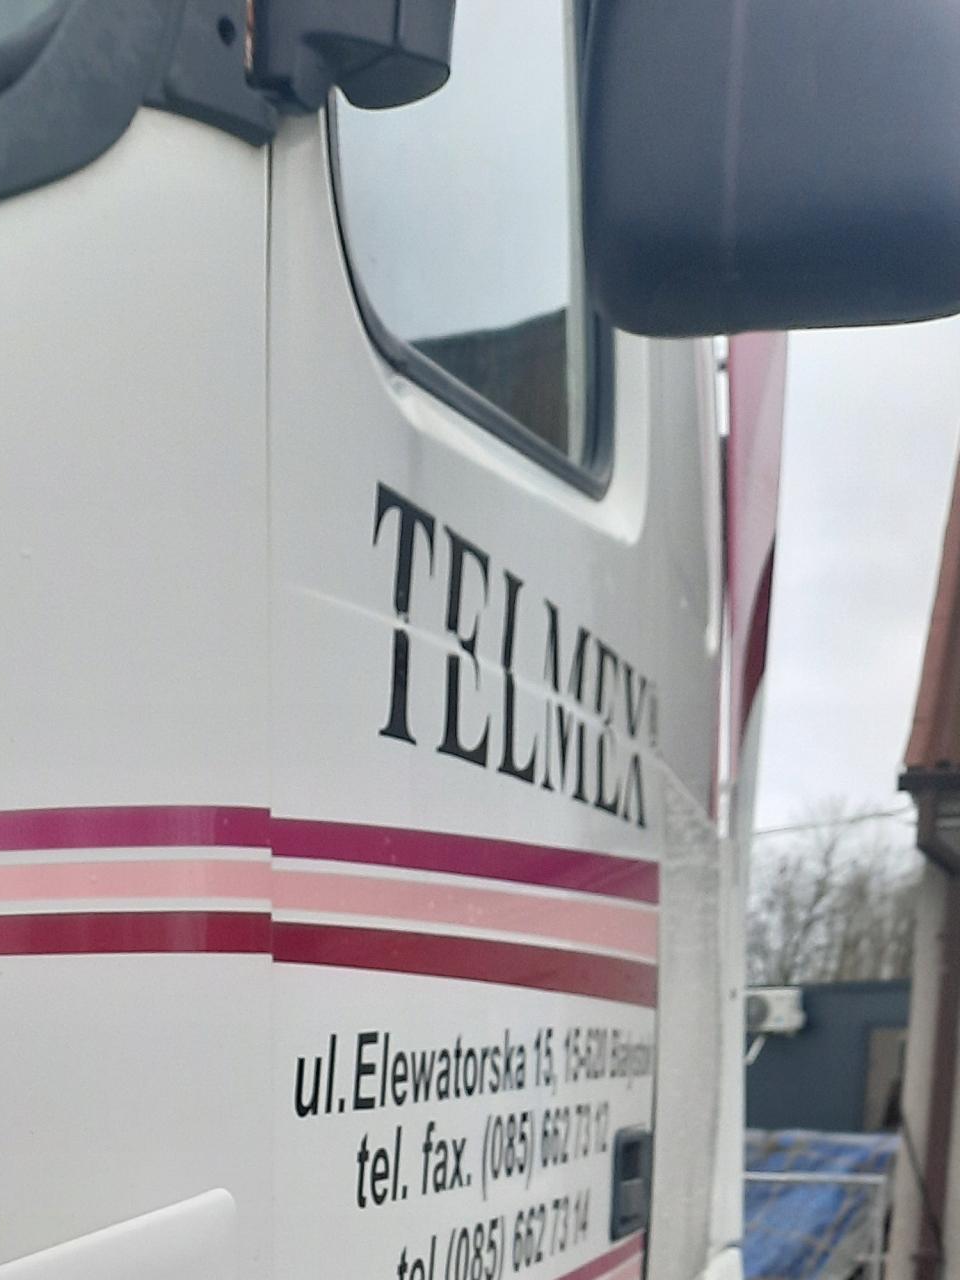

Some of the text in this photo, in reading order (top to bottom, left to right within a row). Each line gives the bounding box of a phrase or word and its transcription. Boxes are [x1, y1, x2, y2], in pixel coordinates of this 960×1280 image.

[373, 481, 649, 829] TELMEX
[356, 1125, 408, 1209] tel.
[422, 1120, 472, 1195] fax.
[481, 1110, 535, 1201] (085)
[511, 1203, 547, 1273] 662
[551, 1196, 570, 1256] 73
